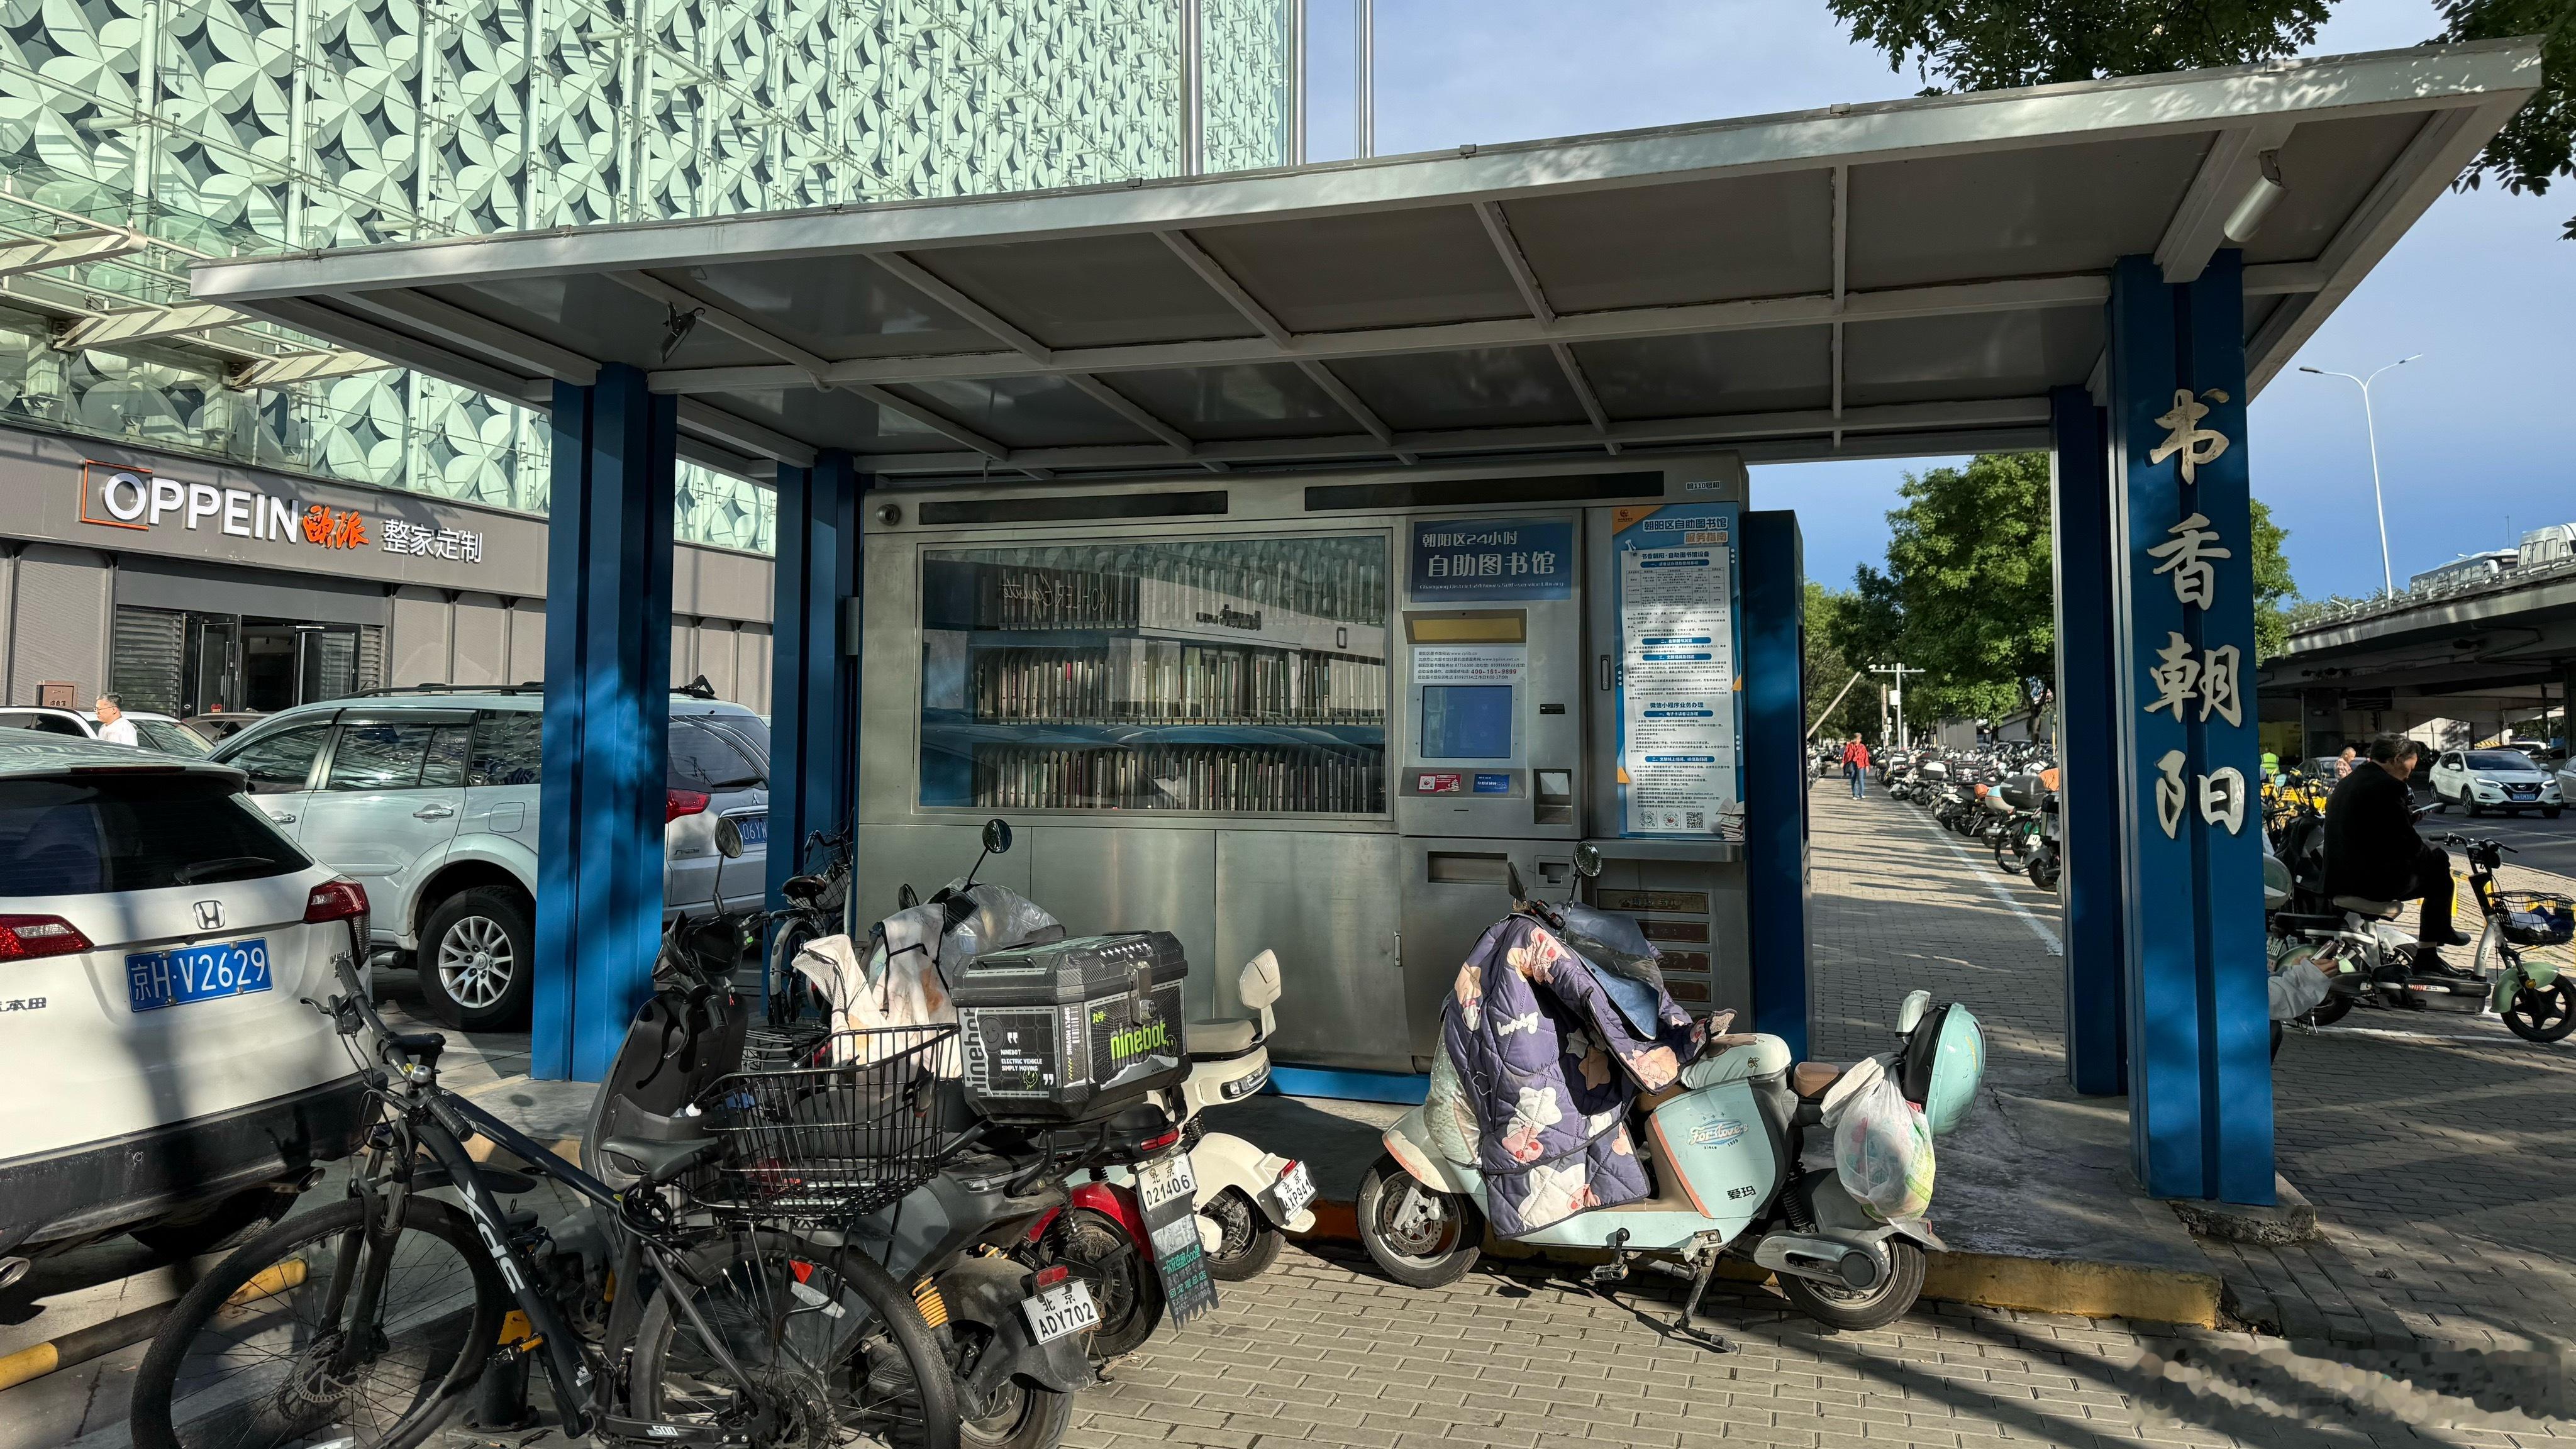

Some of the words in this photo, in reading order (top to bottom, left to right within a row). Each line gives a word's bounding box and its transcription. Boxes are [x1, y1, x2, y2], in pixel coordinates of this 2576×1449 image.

[103, 472, 299, 545] OPPEIN
[1644, 518, 1728, 530] 朝阳区自助图书馆
[382, 519, 483, 563] 整家定制
[1422, 531, 1518, 547] 朝阳区24小时
[1428, 551, 1555, 577] 自助图书馆
[2143, 389, 2245, 840] 书香朝阳
[1092, 1011, 1106, 1024] 九号
[1110, 1019, 1167, 1060] ninebot
[1150, 1159, 1175, 1184] 北京
[1146, 1174, 1191, 1206] D21406
[1726, 1185, 1756, 1201] 爱玛
[1042, 1292, 1076, 1313] 北京
[1038, 1302, 1094, 1338] ADY702
[652, 1425, 679, 1436] 500
